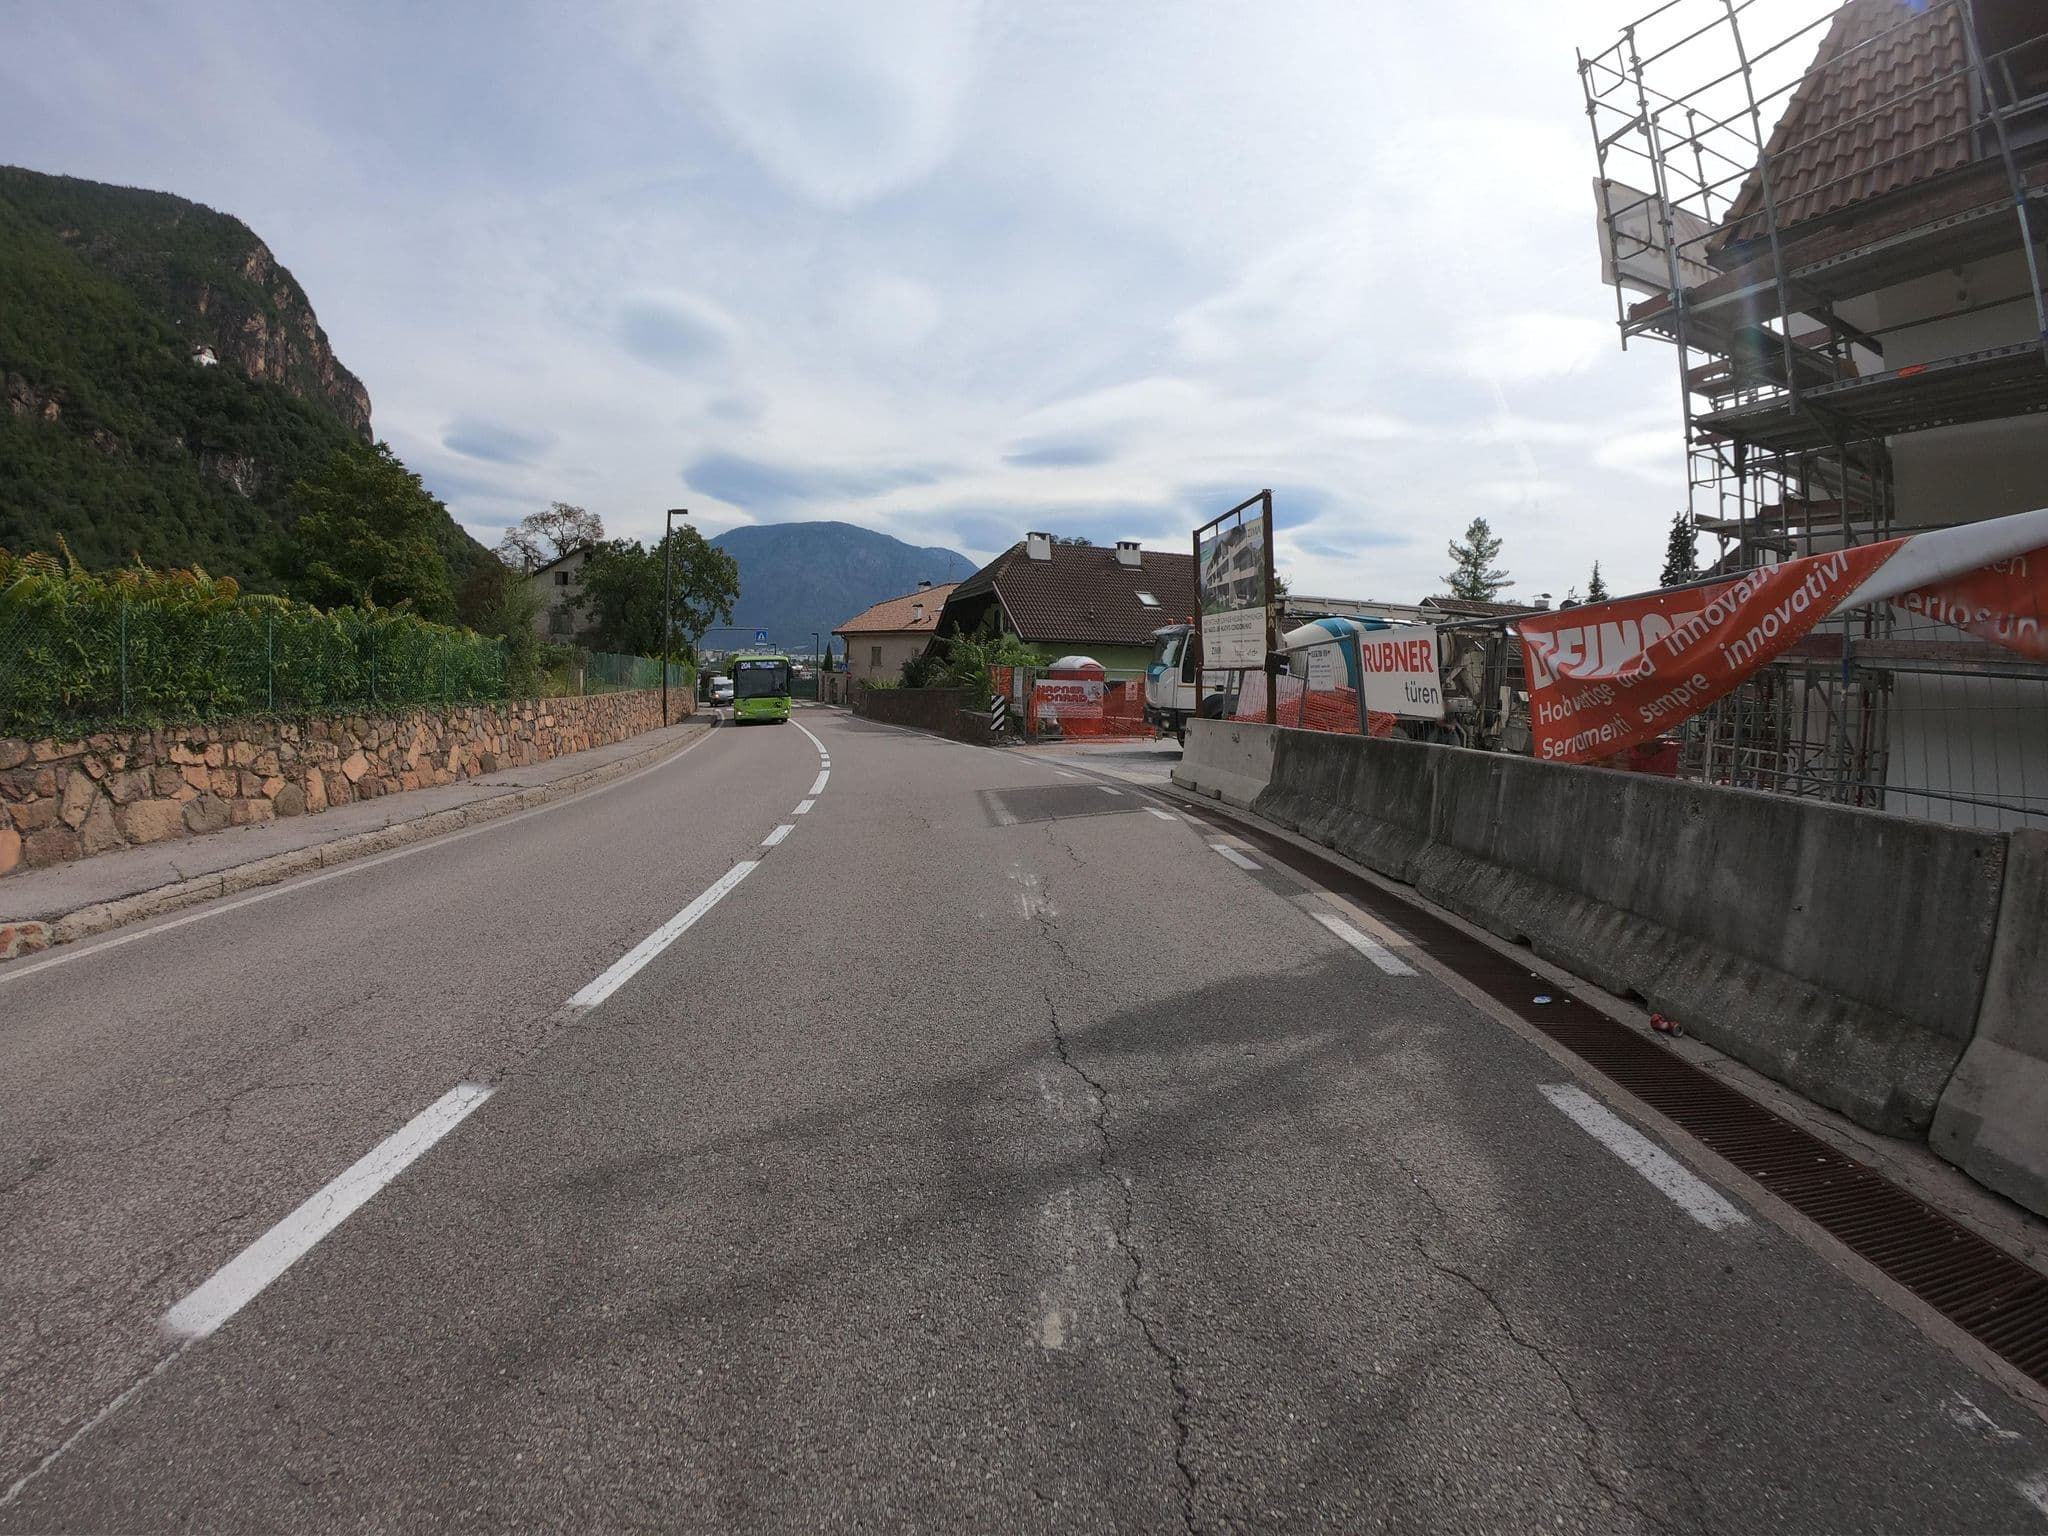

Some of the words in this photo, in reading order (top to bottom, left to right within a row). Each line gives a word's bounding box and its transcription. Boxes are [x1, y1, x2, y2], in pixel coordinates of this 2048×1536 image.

[1639, 673, 1711, 724] sempre
[1719, 551, 1849, 670] innovativi
[1362, 640, 1434, 673] RUBNER
[1405, 680, 1439, 705] türen
